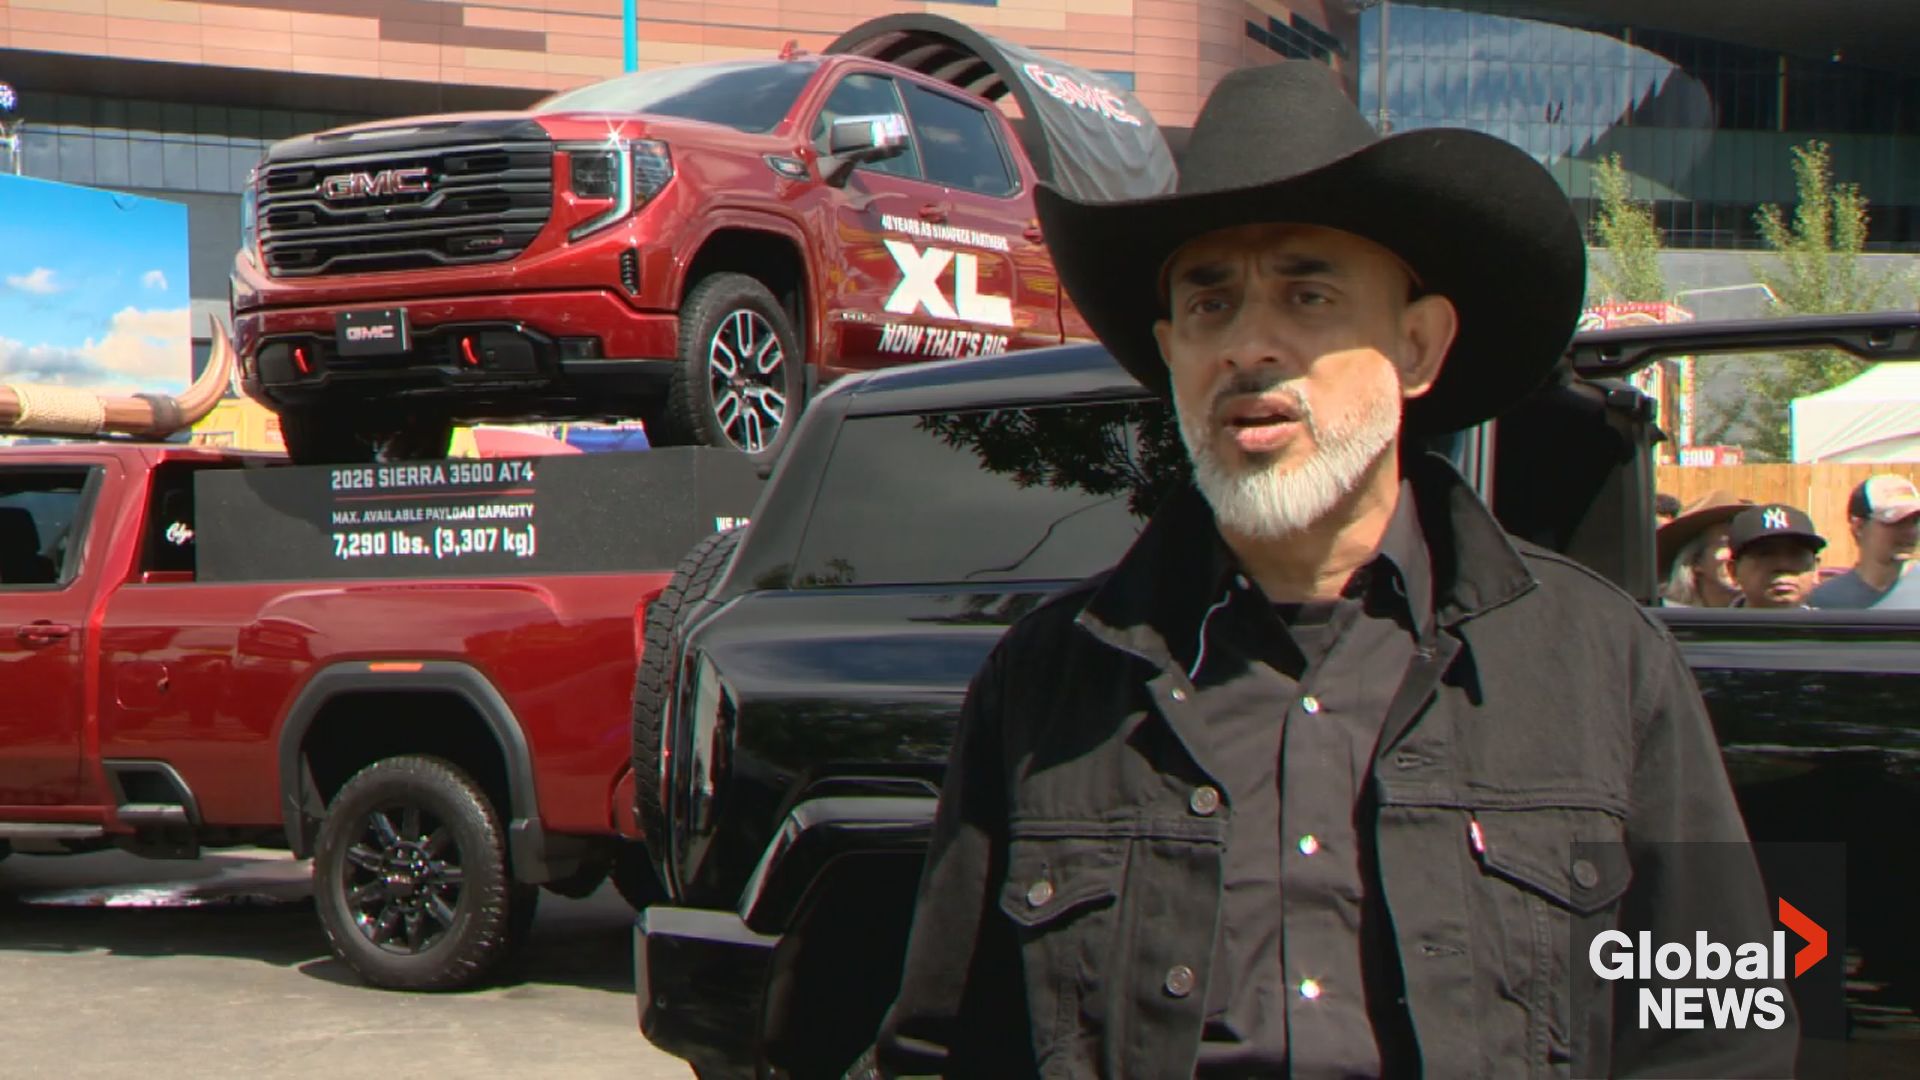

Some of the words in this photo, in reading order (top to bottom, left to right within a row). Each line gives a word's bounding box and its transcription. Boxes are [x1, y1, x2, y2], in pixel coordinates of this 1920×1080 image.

[1023, 63, 1142, 127] GMC
[322, 167, 432, 200] GMC
[893, 216, 920, 236] YEARS
[920, 221, 932, 238] AS
[883, 239, 1014, 328] XL
[345, 324, 395, 341] GMC
[878, 322, 925, 354] NOW
[922, 326, 982, 359] THAT'S
[331, 468, 375, 490] 2026
[377, 465, 446, 489] SIERRA
[450, 462, 494, 484] 3500
[498, 461, 534, 482] AT4
[332, 510, 361, 525] MAX.
[362, 507, 425, 524] AVAILABLE
[425, 505, 476, 521] PAYLOAD
[477, 503, 535, 520] CAPACITY
[333, 531, 387, 560] 7,290
[391, 529, 431, 556] lbs.
[434, 526, 499, 560] (3,307
[502, 523, 537, 557] kg)
